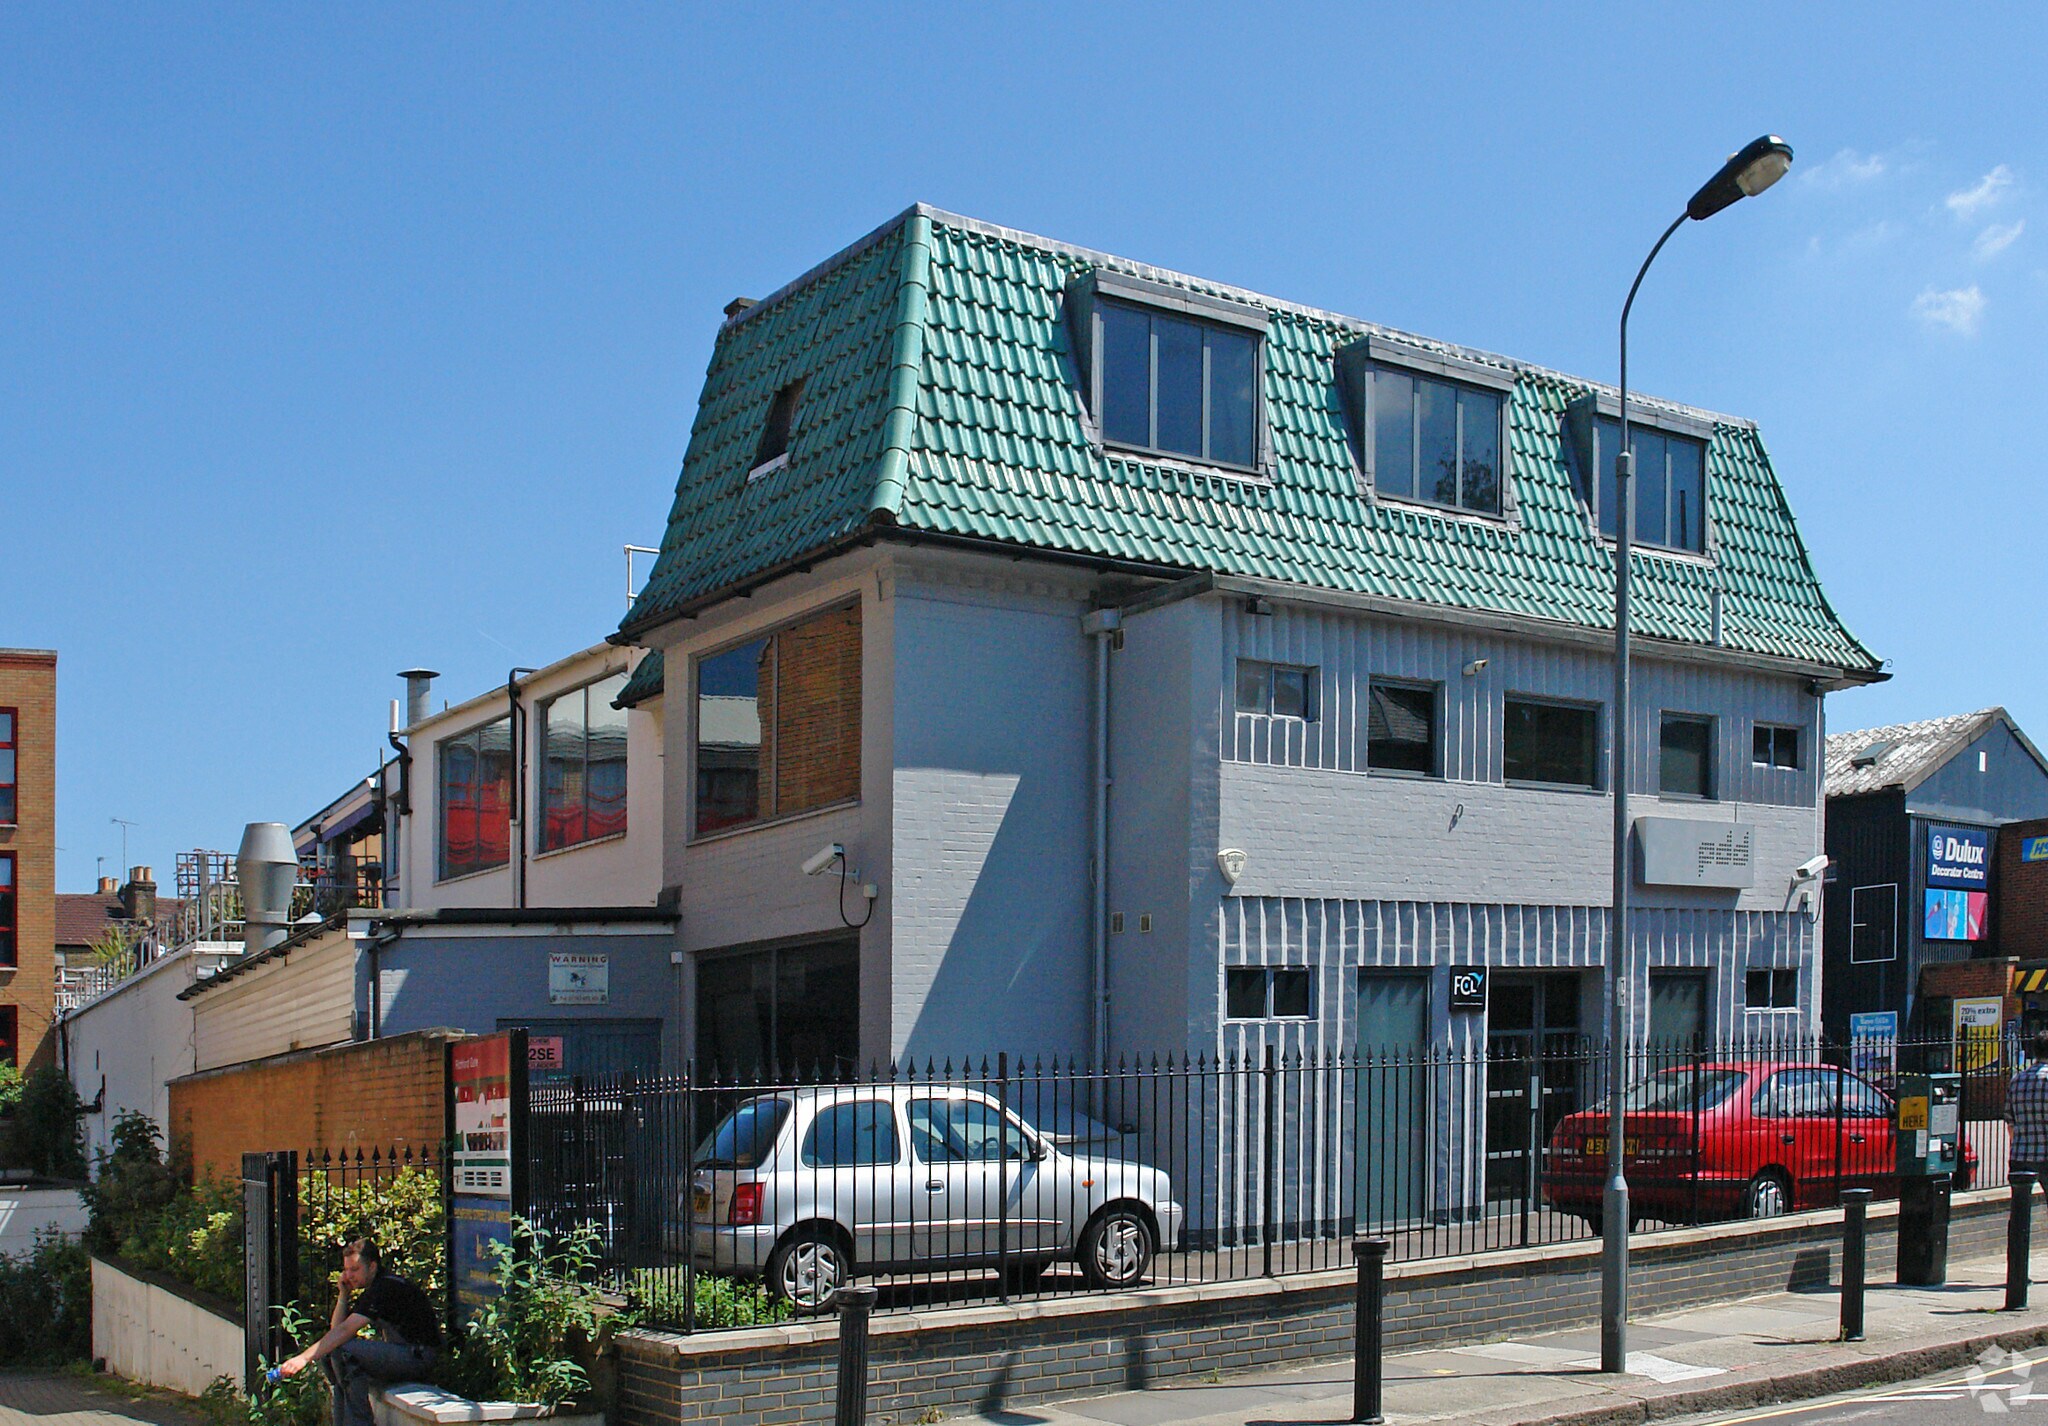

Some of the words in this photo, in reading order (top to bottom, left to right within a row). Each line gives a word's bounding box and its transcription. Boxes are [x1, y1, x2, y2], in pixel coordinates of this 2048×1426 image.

[1945, 837, 1984, 864] Dulux
[1931, 864, 1963, 878] Decorator
[1963, 867, 1984, 880] Centre
[1454, 975, 1477, 995] FCL
[1978, 1006, 1997, 1014] extra
[1960, 1014, 1977, 1023] FREE
[529, 1048, 555, 1060] 2SE
[1902, 1115, 1924, 1128] HERE
